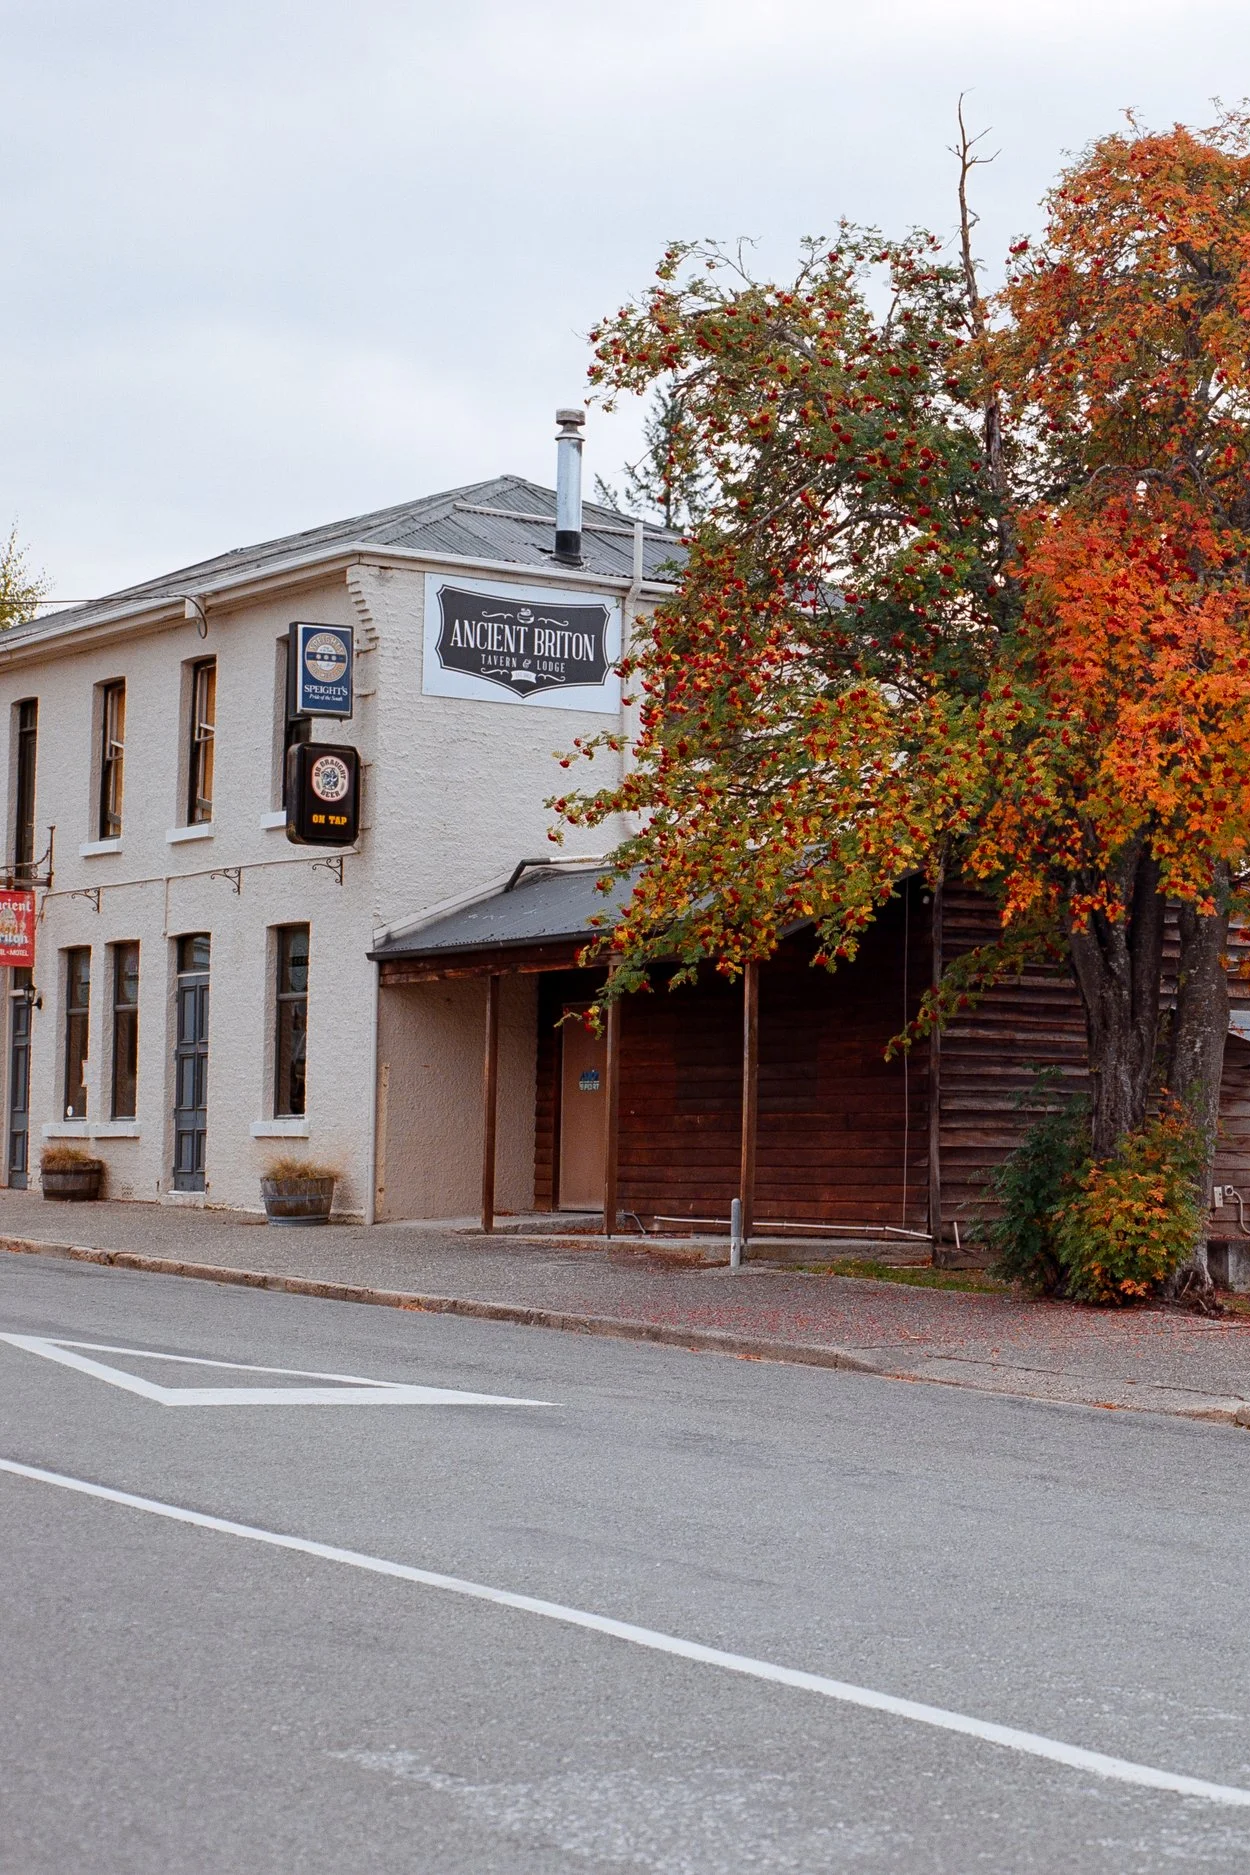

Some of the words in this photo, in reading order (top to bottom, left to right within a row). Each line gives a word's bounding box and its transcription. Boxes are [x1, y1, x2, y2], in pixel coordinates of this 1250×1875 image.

[450, 619, 529, 654] ANCIENT
[533, 628, 596, 662] BRITON
[481, 654, 517, 668] TAVERN
[522, 658, 532, 669] &
[536, 660, 566, 674] LODGE
[304, 684, 348, 696] SPEIGHT'S
[319, 759, 346, 780] DRAUGHT
[320, 790, 341, 798] BEER
[312, 814, 326, 824] ON
[328, 815, 348, 826] TAP
